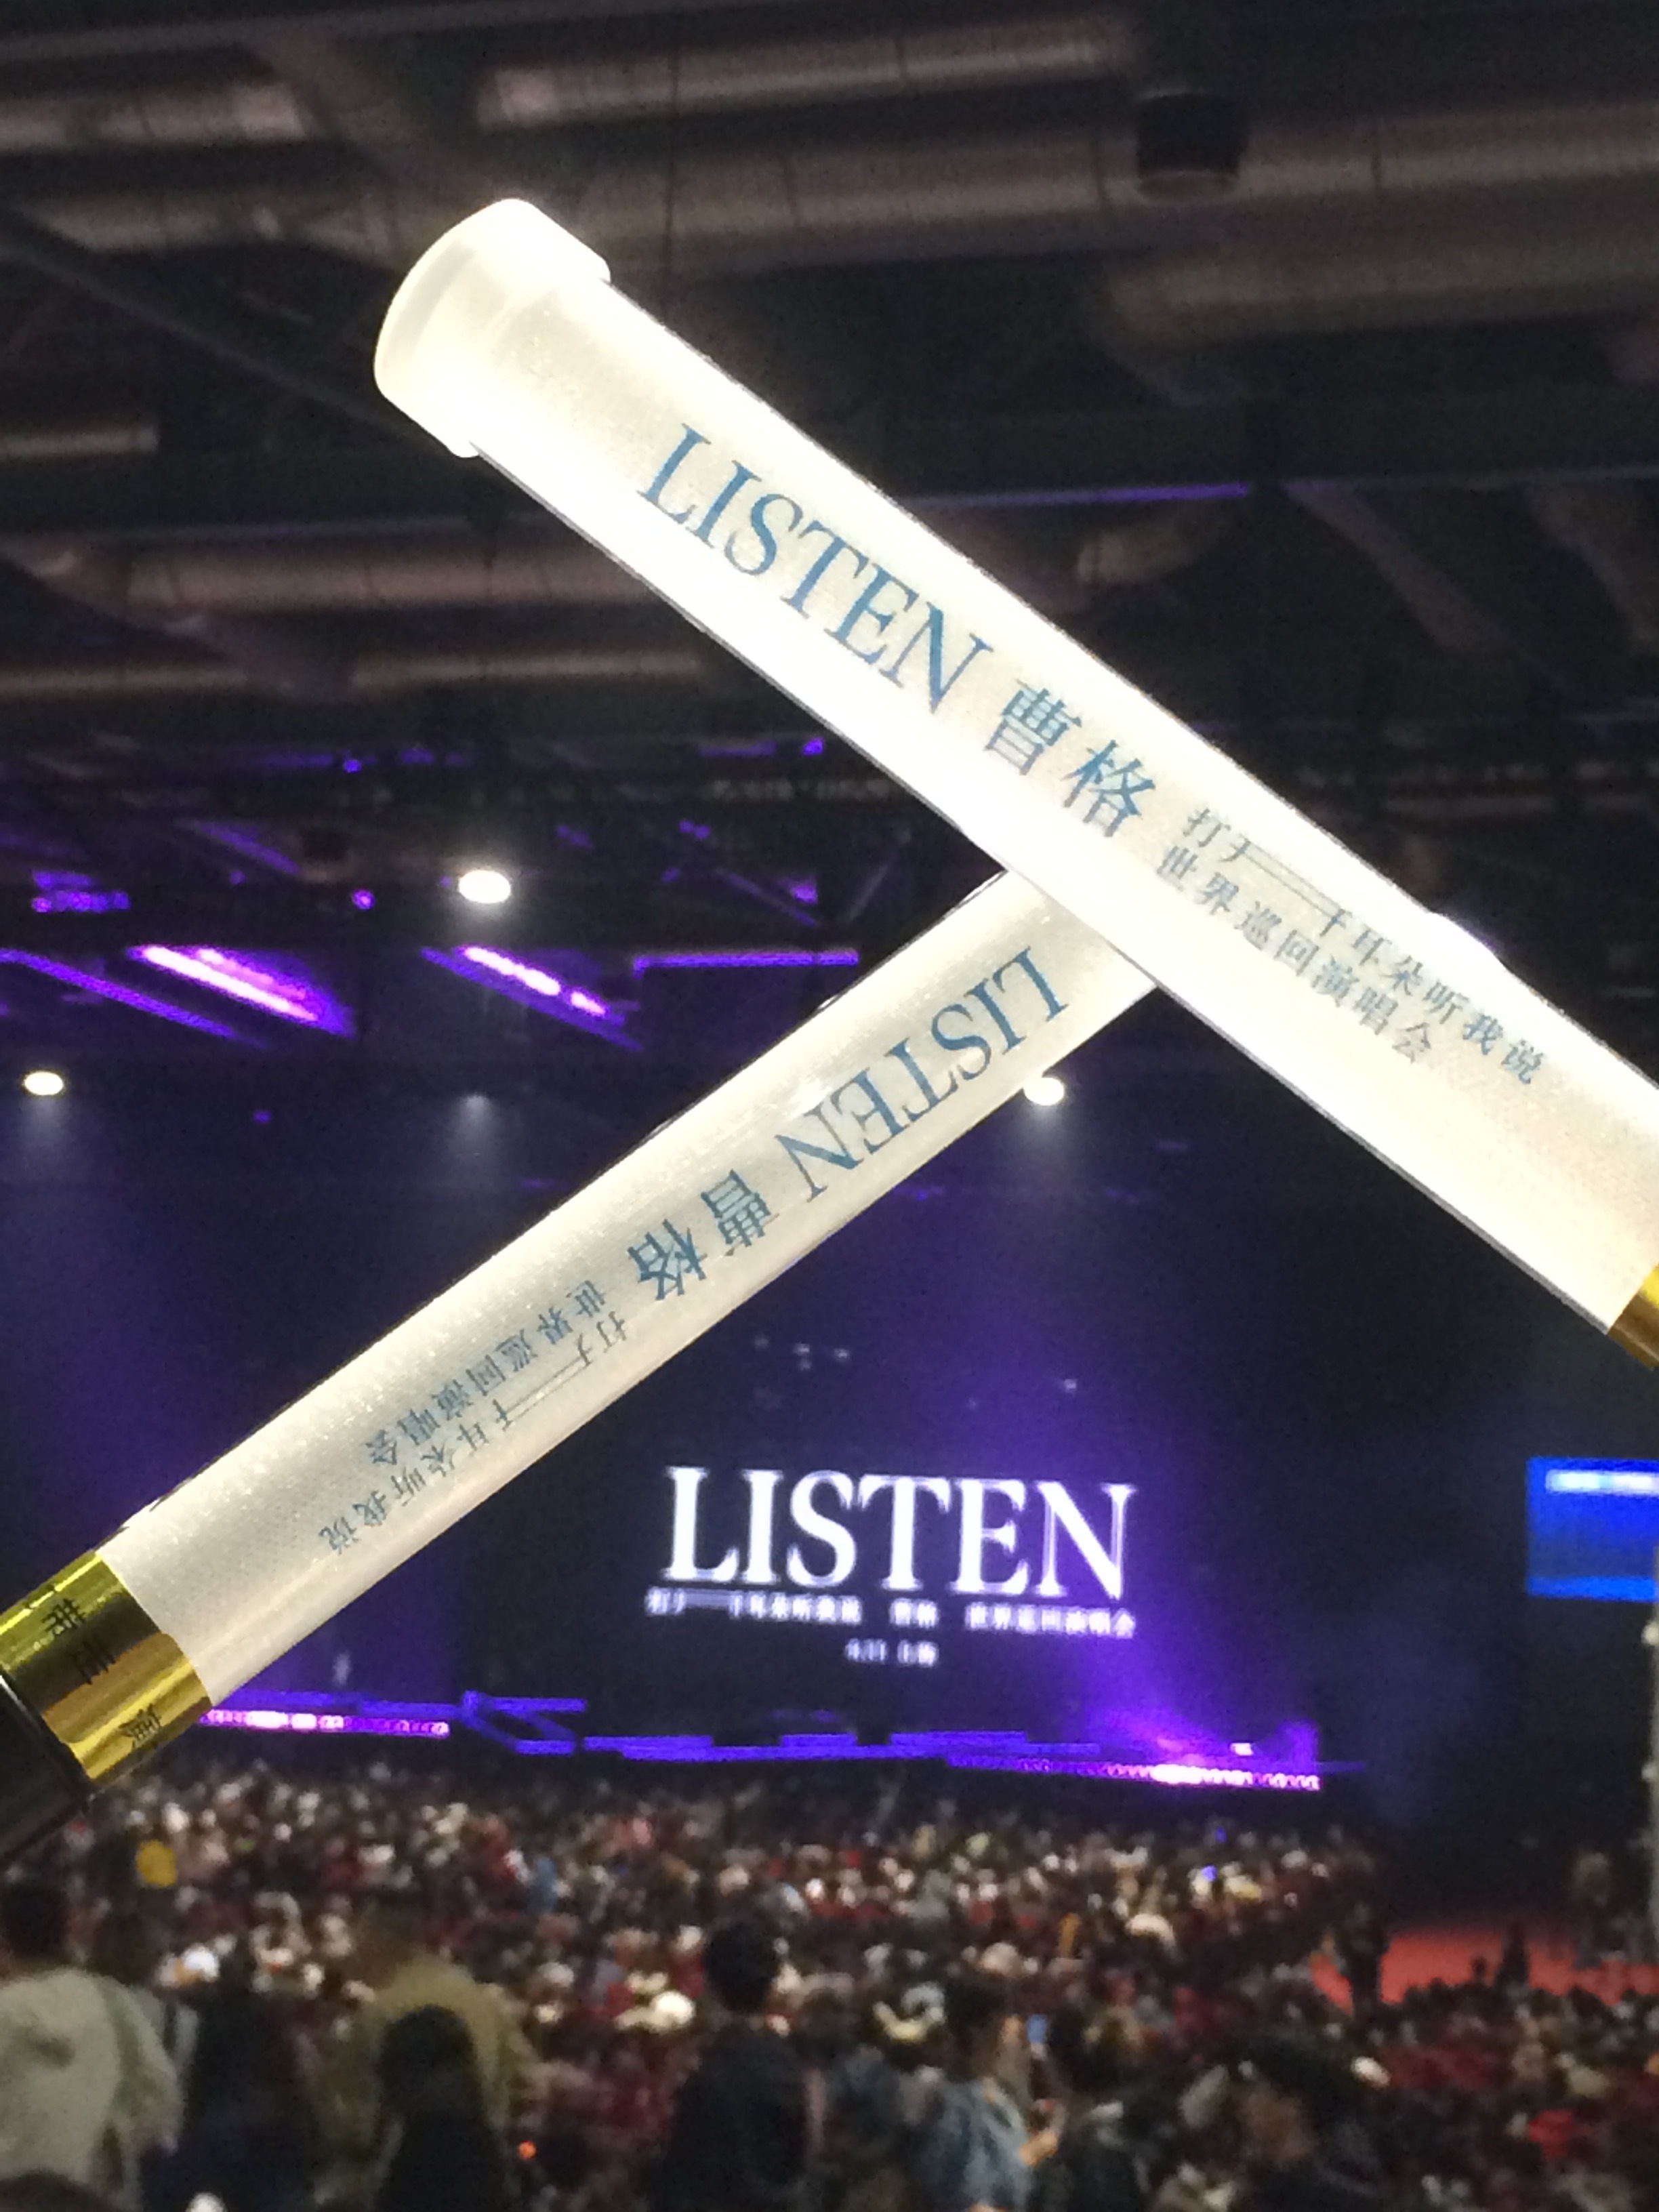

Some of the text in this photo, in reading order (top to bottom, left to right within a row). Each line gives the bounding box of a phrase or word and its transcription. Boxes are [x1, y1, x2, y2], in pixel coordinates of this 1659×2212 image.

[637, 423, 1156, 838] LISTEN 曹格
[1156, 845, 1433, 1063] 世界巡回演唱会
[627, 947, 1068, 1301] LISTEN 曹格
[367, 1279, 607, 1467] 世界巡回演唱会
[661, 1465, 1137, 1601] LISTEN
